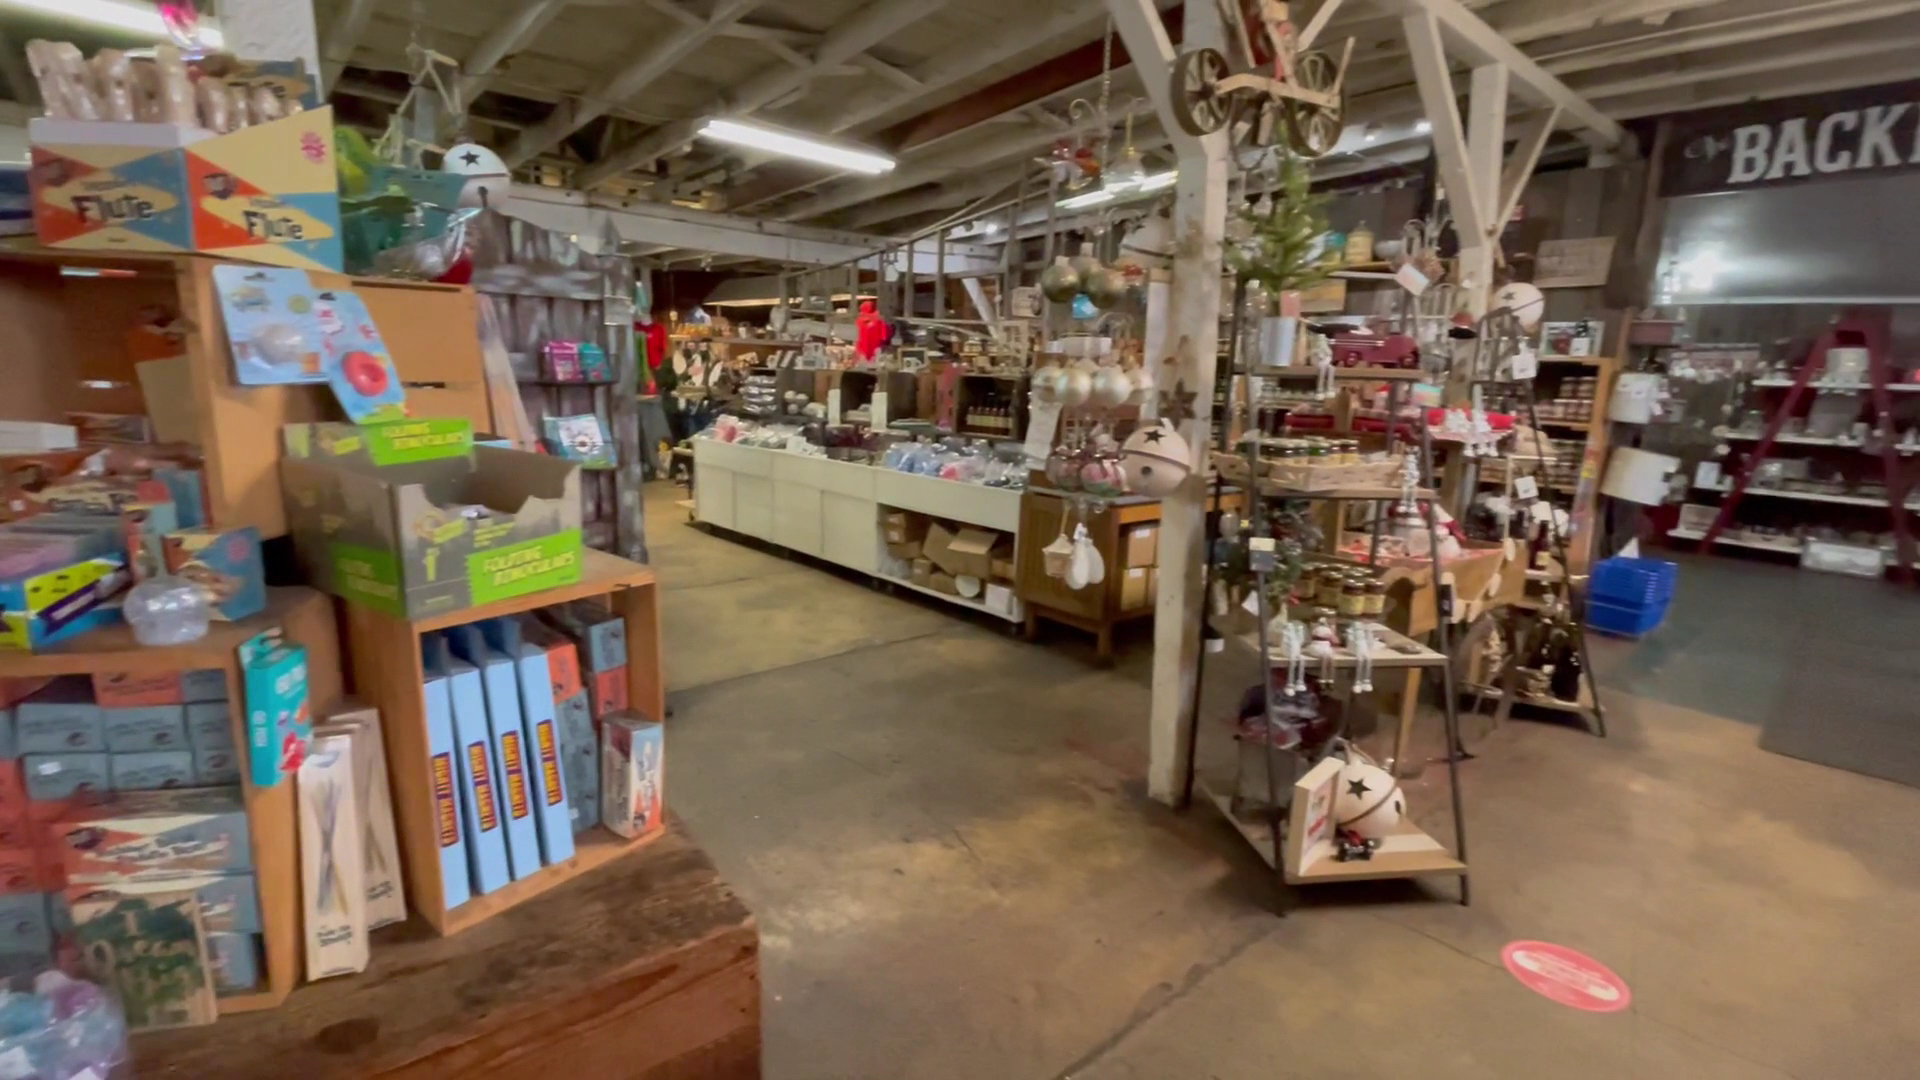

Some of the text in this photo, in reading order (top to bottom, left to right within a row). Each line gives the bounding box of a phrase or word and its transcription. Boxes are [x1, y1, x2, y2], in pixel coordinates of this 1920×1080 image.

[1726, 102, 1920, 184] BACK
[70, 193, 154, 224] Flute
[242, 209, 304, 240] Flute
